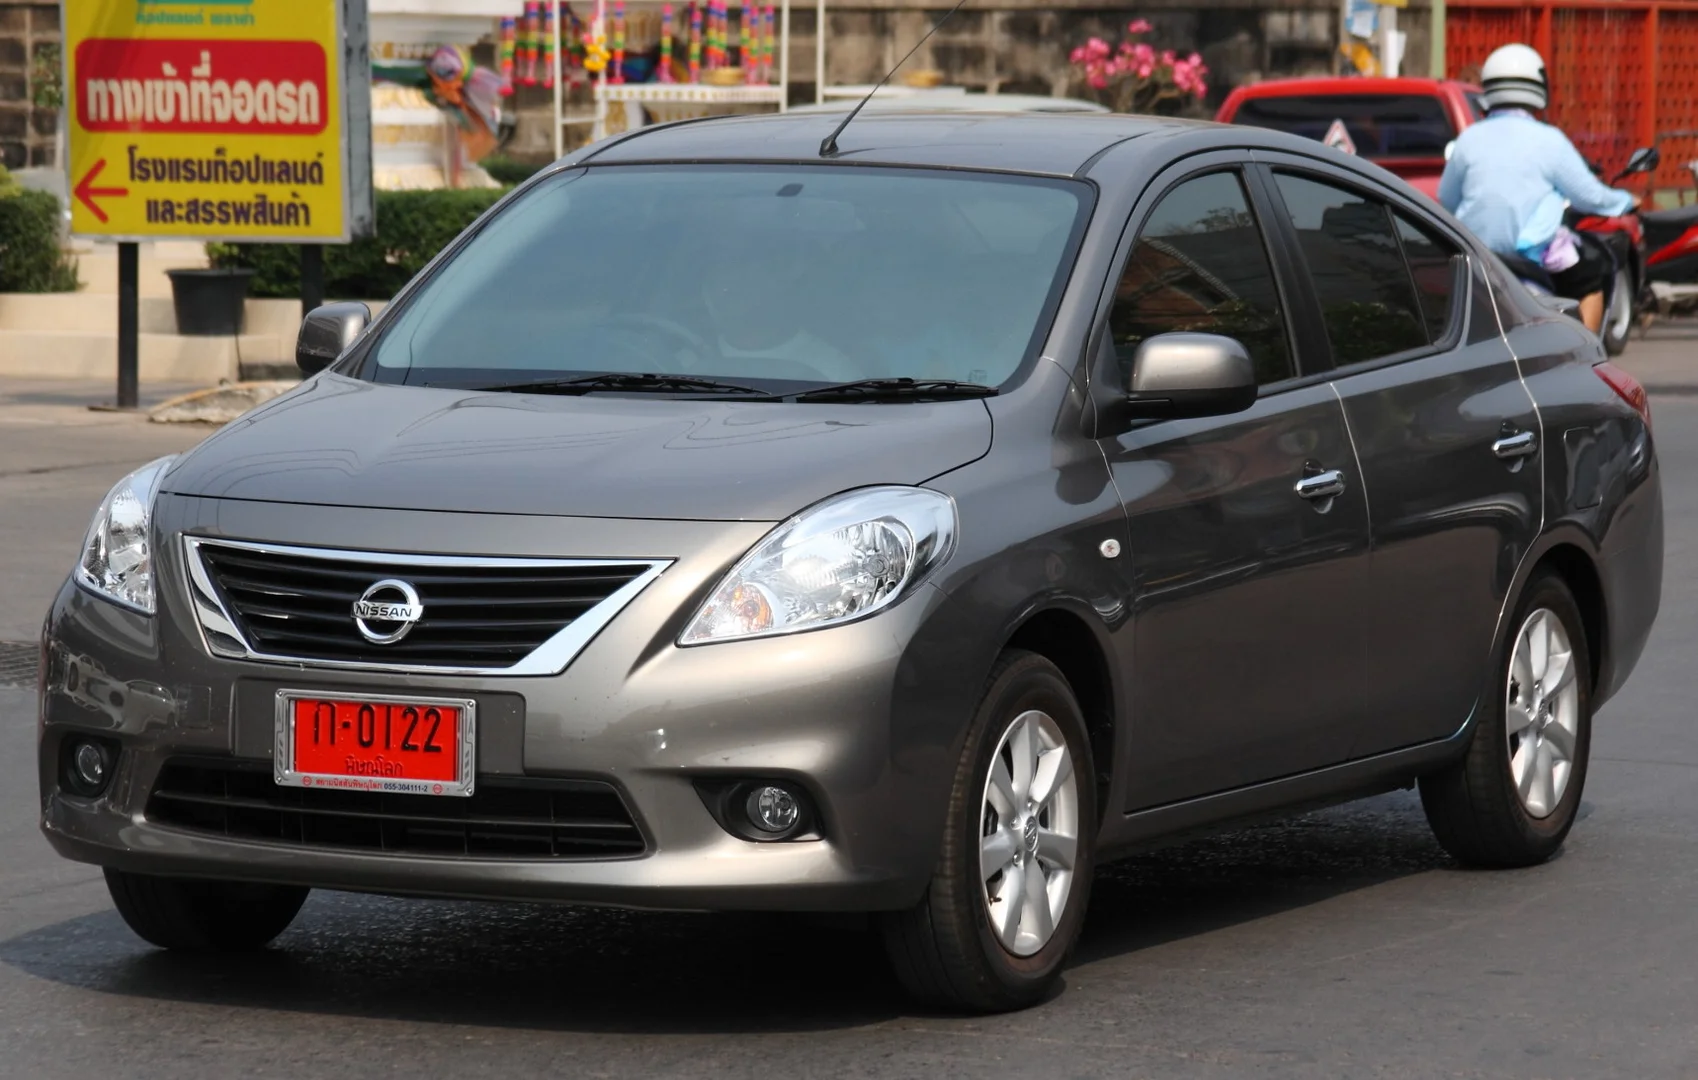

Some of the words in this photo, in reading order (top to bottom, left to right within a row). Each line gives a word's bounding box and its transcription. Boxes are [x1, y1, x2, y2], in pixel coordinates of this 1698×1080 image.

[87, 50, 320, 124] ทางเข้าที่จอดรถ
[127, 145, 324, 185] โรงแรมท็อปแลนด์
[146, 191, 311, 227] และสรรพสินค้า
[355, 603, 412, 618] NISSAN
[314, 701, 442, 753] ก-0122
[345, 755, 404, 777] พิษณโลก
[384, 783, 428, 794] 055-304111-2
